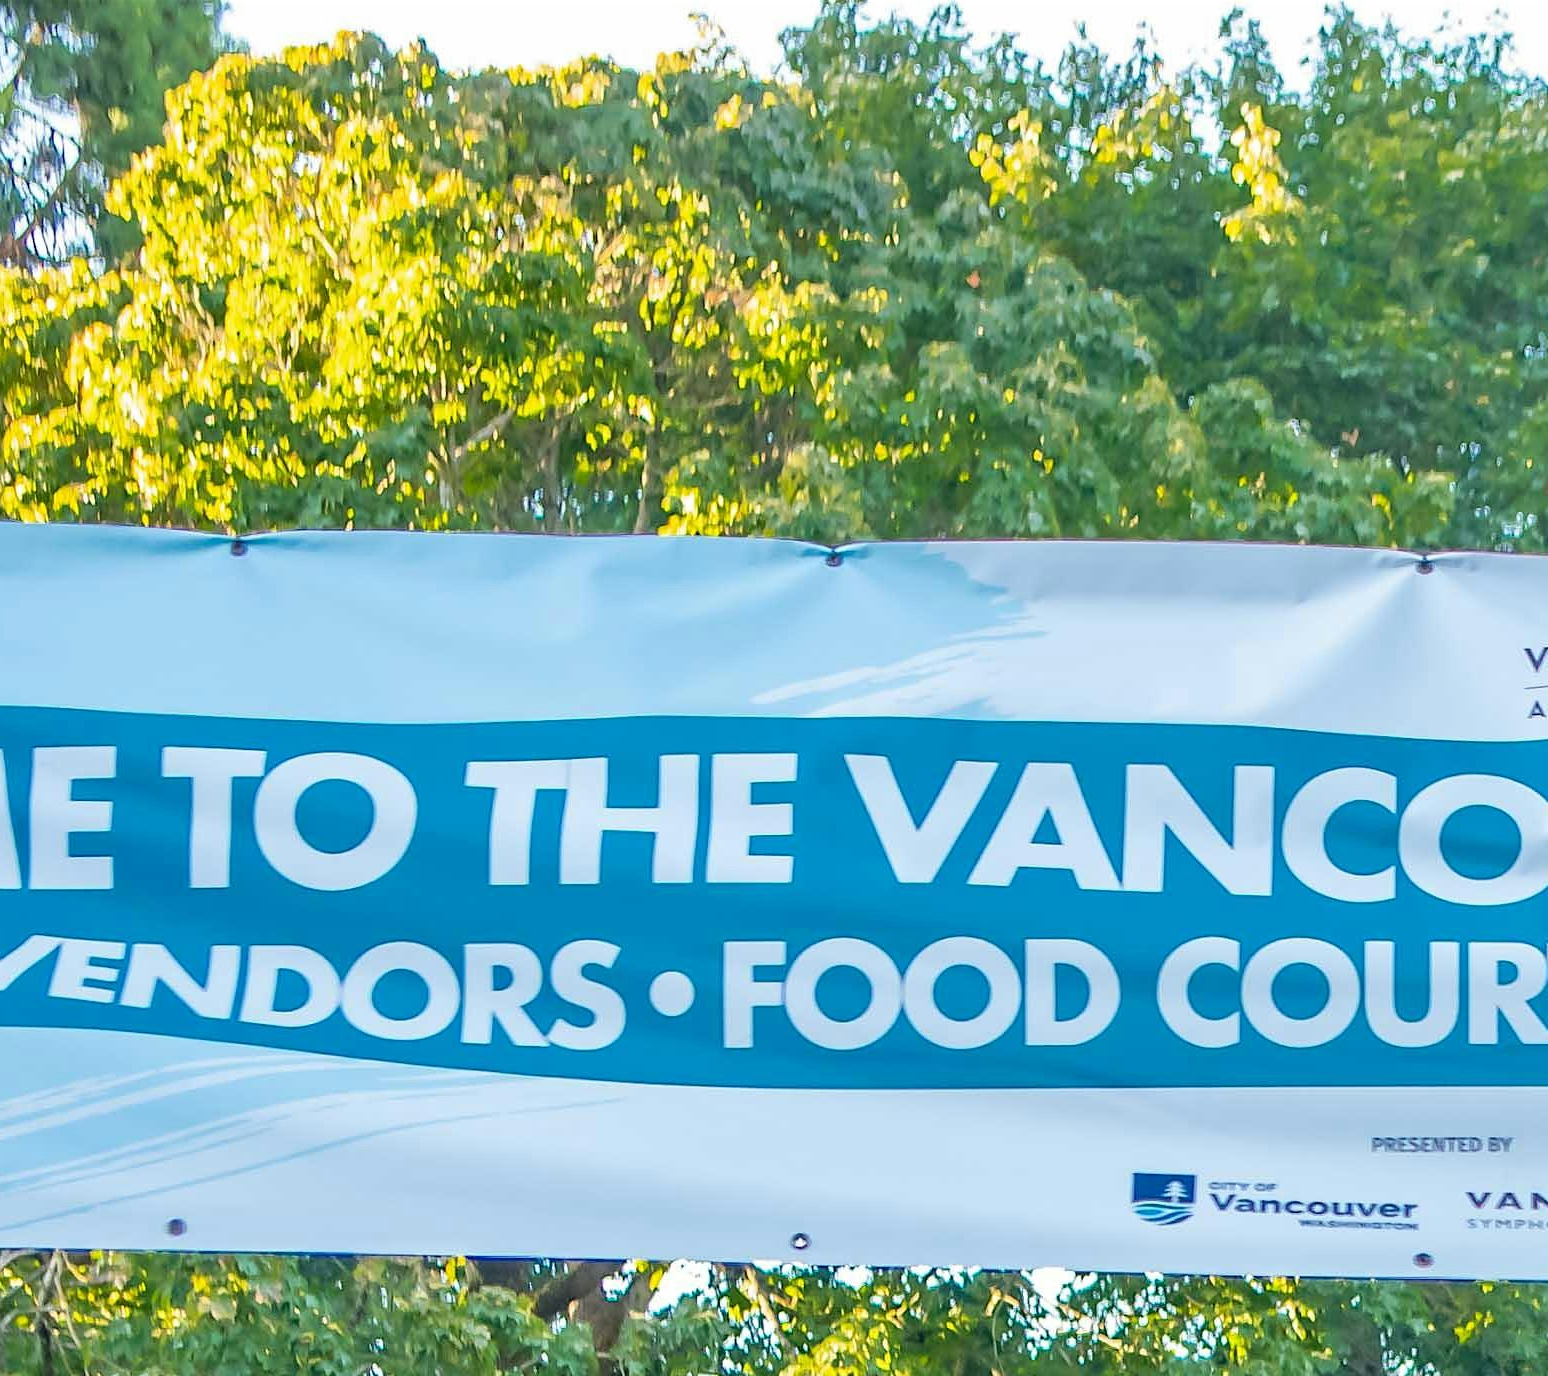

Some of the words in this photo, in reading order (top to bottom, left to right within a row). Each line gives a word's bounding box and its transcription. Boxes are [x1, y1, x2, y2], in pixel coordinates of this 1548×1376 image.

[160, 747, 416, 891] TO
[464, 752, 799, 885] THE
[723, 936, 1121, 1050] FOOD
[1372, 1136, 1483, 1153] PRESENTED
[1488, 1136, 1513, 1153] BY
[1208, 1181, 1251, 1193] CITY
[1254, 1182, 1278, 1193] OF
[1208, 1193, 1419, 1221] Vancouver
[1298, 1217, 1420, 1232] WASHINGTON
